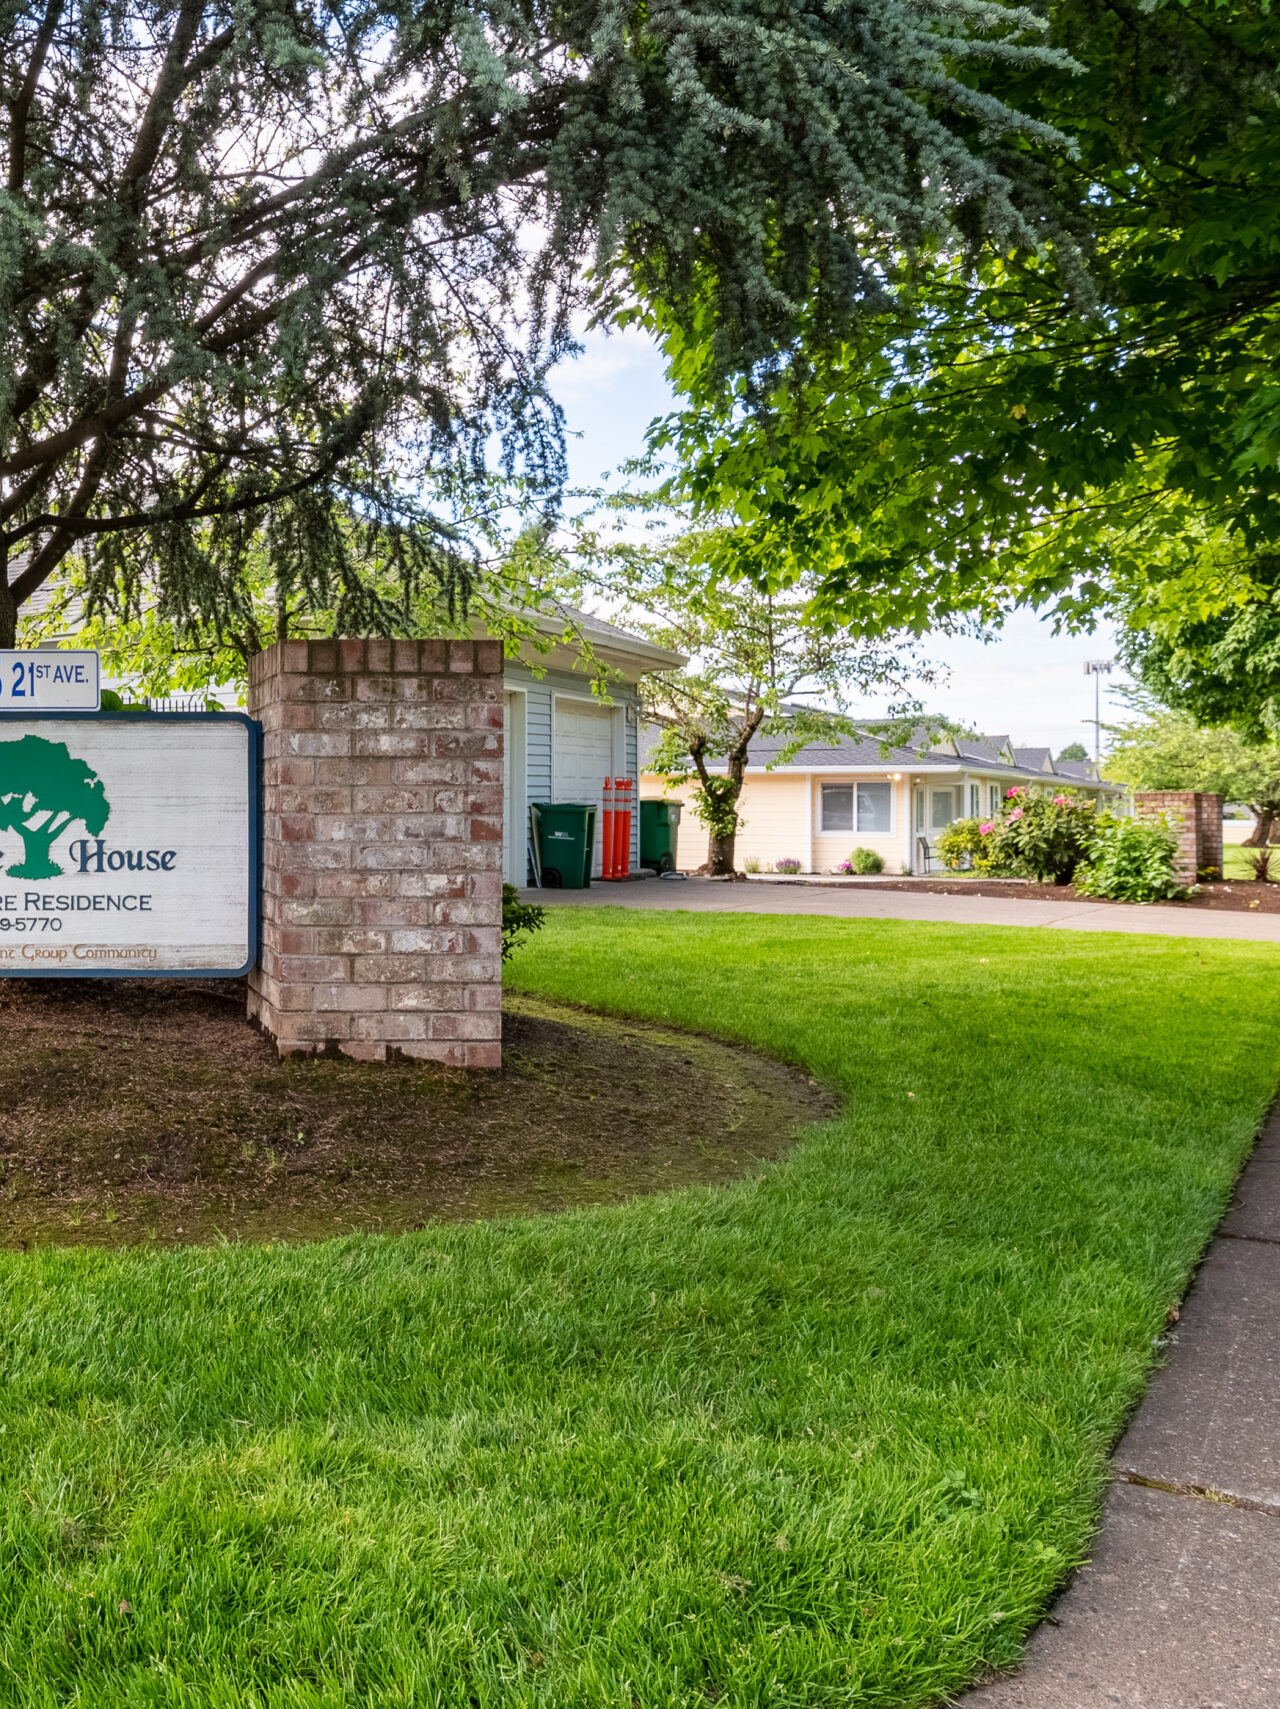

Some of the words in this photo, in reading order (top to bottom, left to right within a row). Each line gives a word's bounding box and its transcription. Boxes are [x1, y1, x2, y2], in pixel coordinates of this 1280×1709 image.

[11, 661, 51, 697] 21ST
[52, 665, 89, 683] AVE.
[69, 839, 177, 873] House
[24, 892, 152, 911] RESIDENCE
[21, 944, 68, 963] Group
[72, 944, 158, 962] Community
